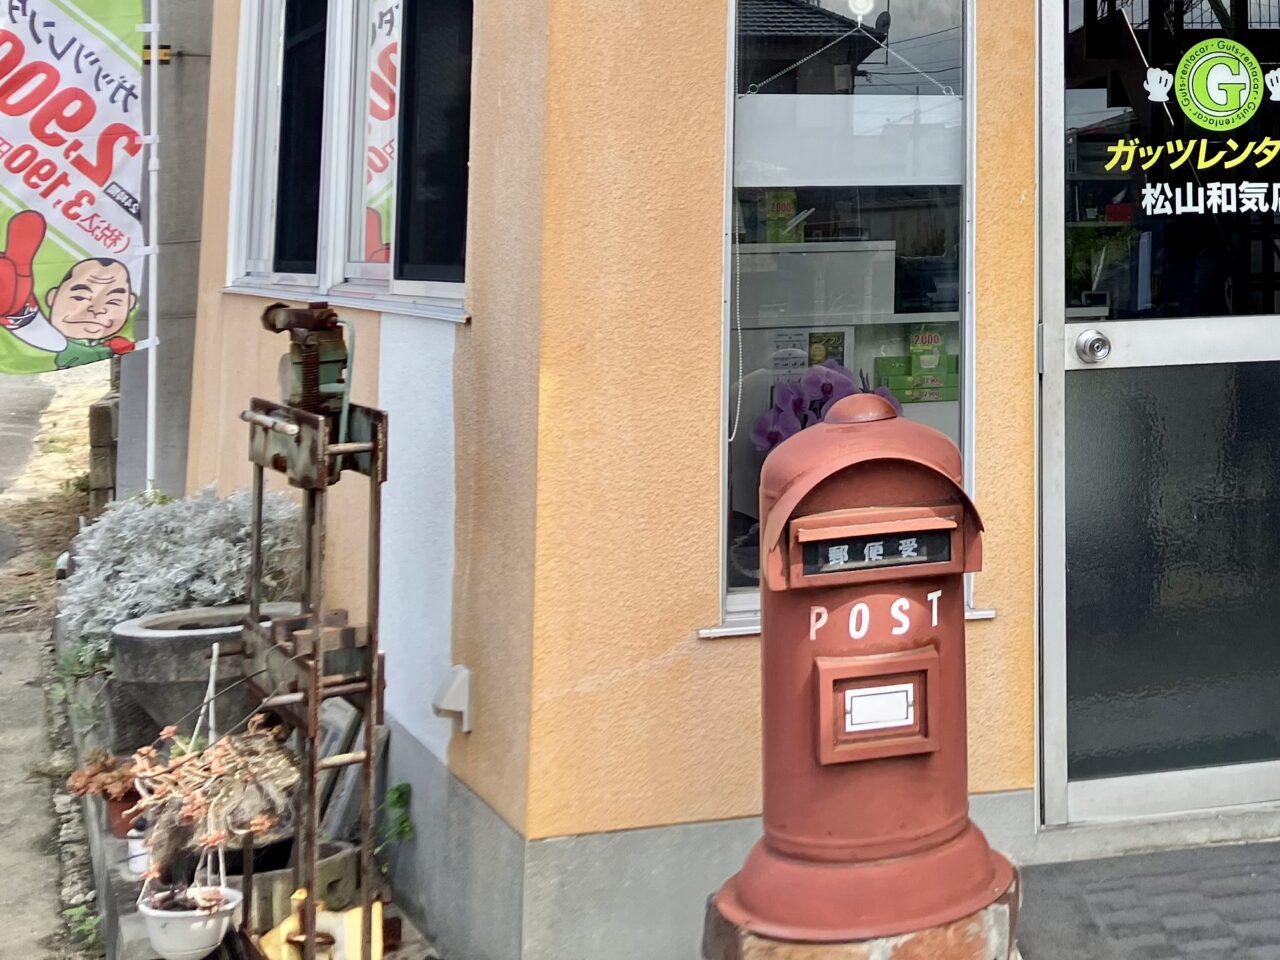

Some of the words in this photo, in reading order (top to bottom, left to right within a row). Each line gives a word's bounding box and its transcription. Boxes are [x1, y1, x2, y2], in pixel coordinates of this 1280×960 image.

[1192, 55, 1248, 113] G
[828, 537, 917, 566] 郵便受
[810, 590, 942, 640] POST
